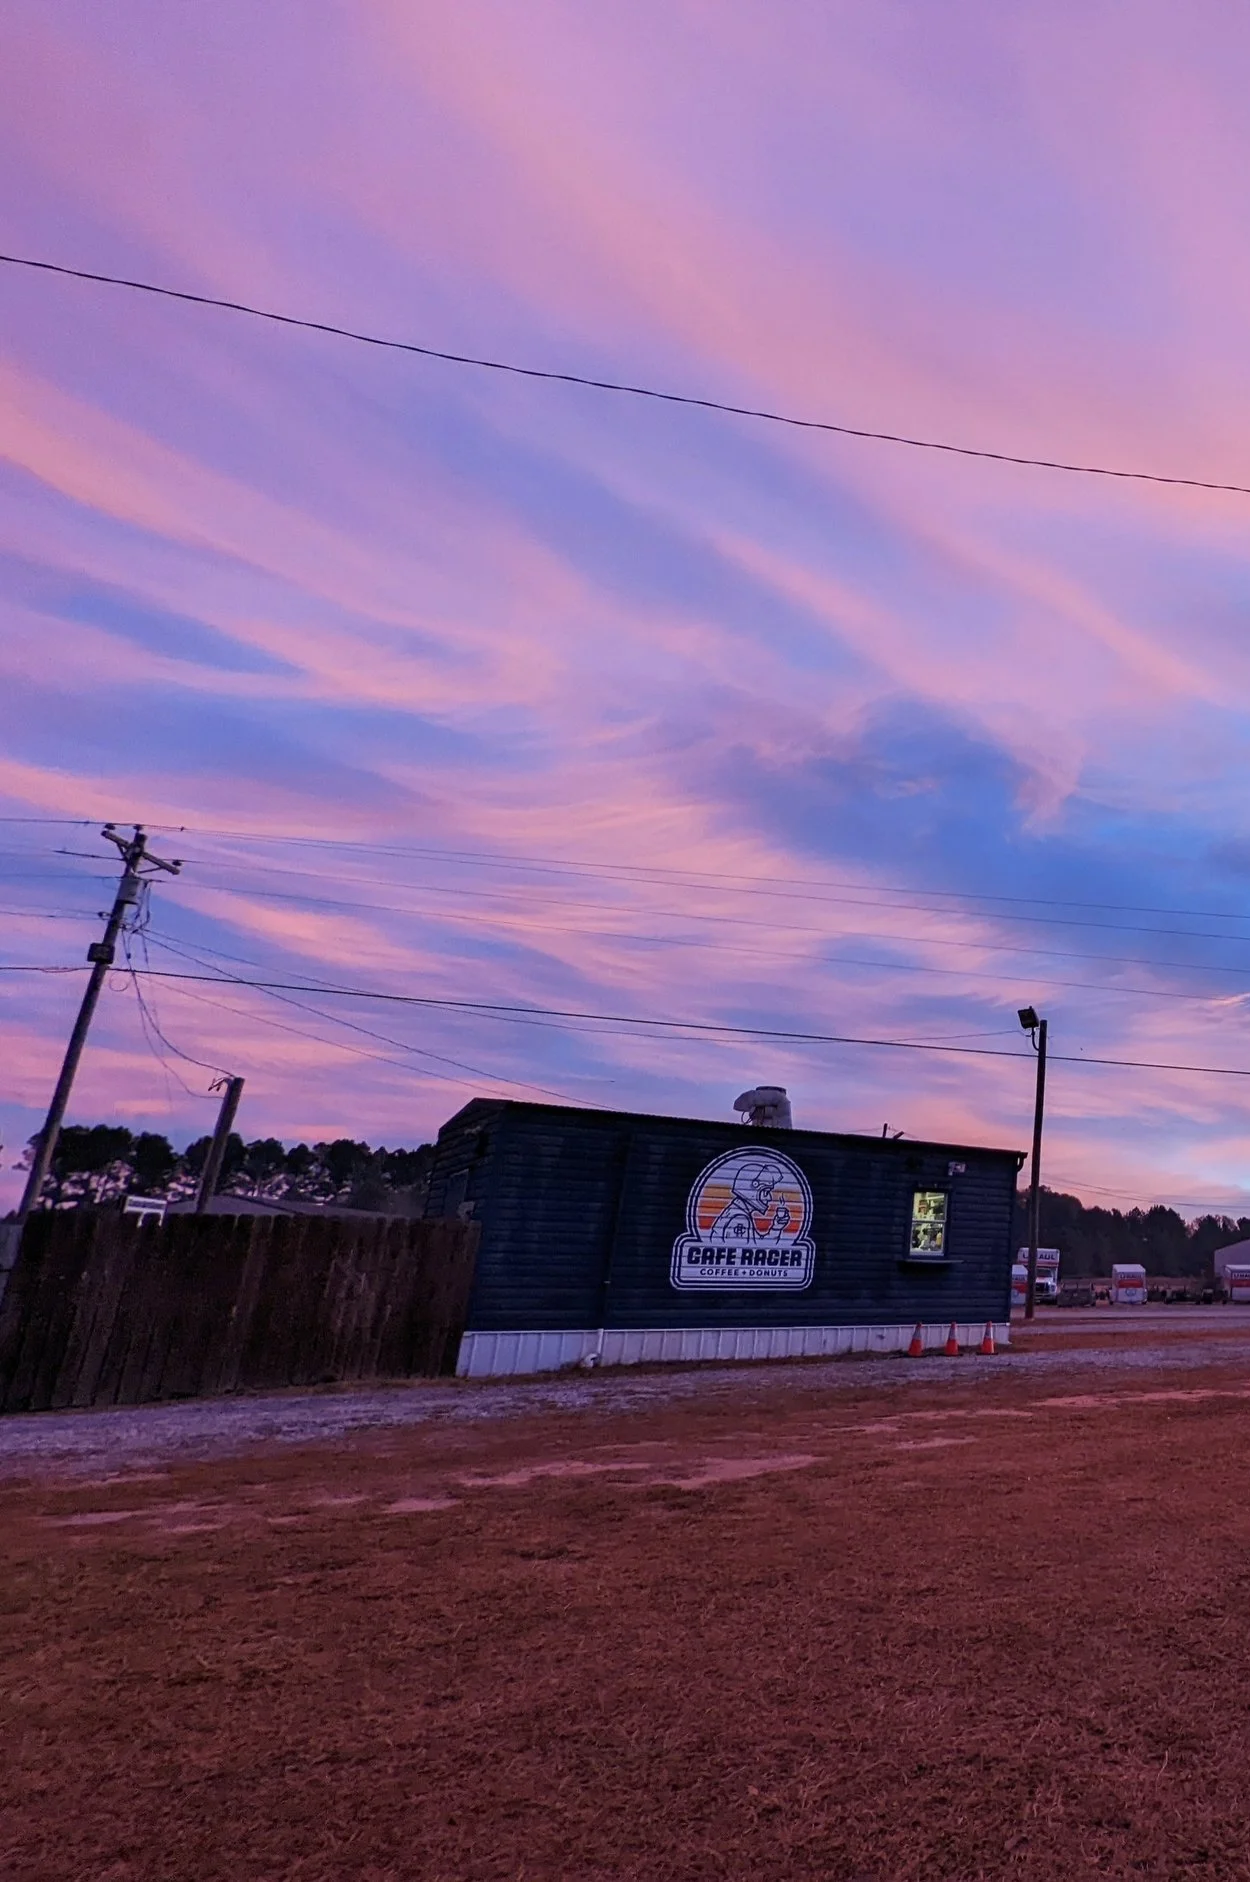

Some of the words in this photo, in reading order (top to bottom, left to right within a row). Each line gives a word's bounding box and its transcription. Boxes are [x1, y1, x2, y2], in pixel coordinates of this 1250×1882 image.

[687, 1246, 736, 1265] CAFE
[741, 1248, 802, 1266] RACER
[700, 1268, 739, 1276] COFFEE
[749, 1269, 788, 1277] DONUTS
